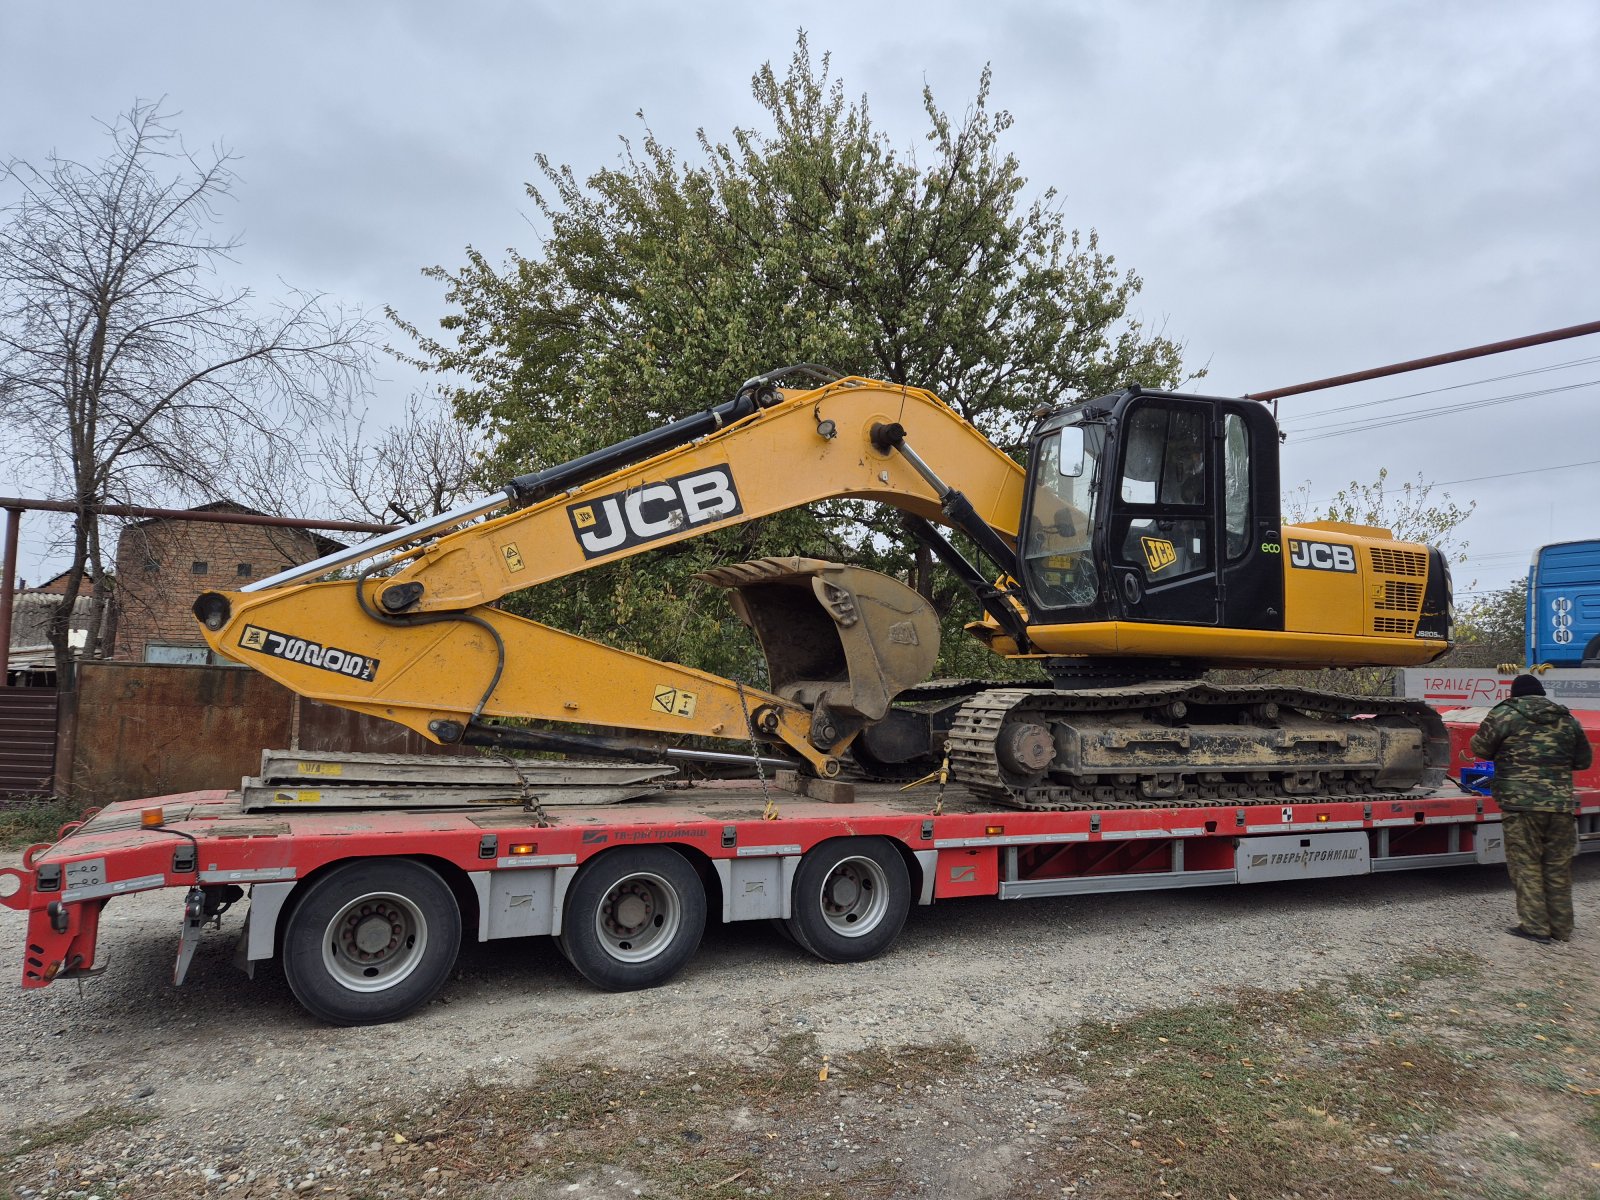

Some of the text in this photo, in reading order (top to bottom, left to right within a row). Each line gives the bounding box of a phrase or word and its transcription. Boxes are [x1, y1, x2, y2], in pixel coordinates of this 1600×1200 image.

[581, 471, 736, 552] JCB
[1146, 540, 1176, 568] JCB
[1261, 543, 1280, 554] eco
[1291, 541, 1356, 571] JCB
[1555, 630, 1569, 643] 60
[268, 633, 364, 676] JS205
